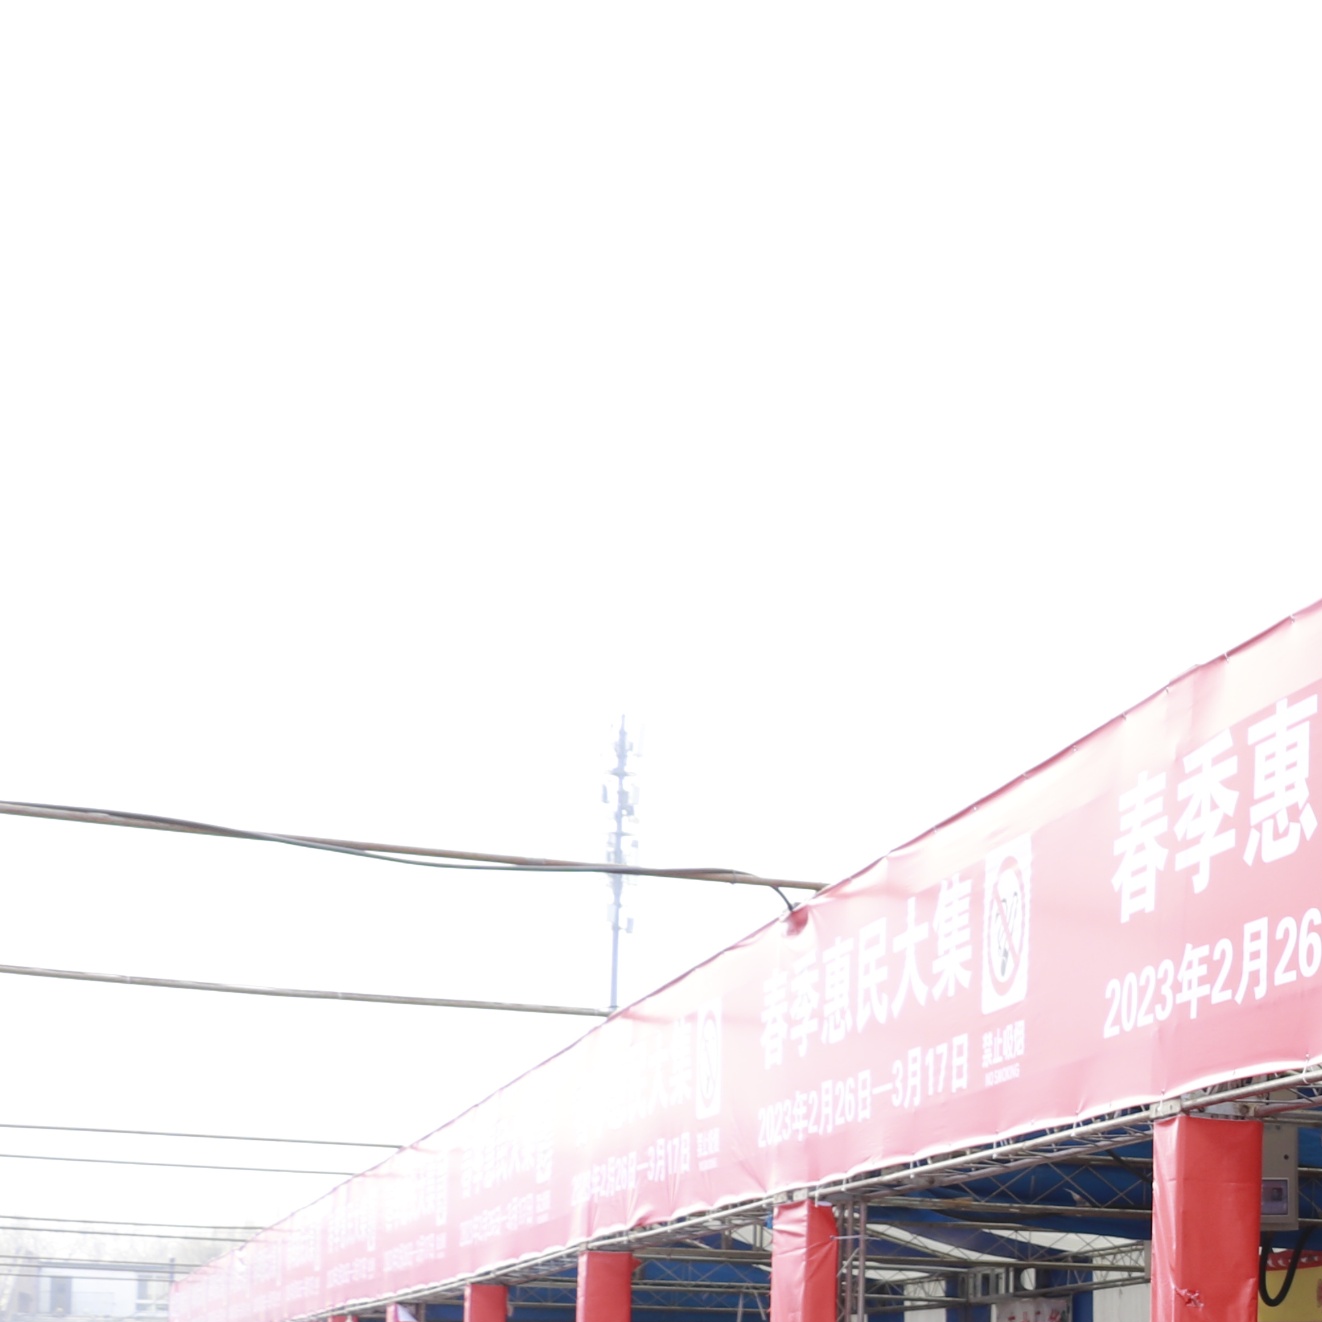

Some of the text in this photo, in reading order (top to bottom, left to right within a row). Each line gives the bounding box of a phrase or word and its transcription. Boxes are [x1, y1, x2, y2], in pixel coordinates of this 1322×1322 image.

[759, 872, 974, 1071] 春季惠民大集
